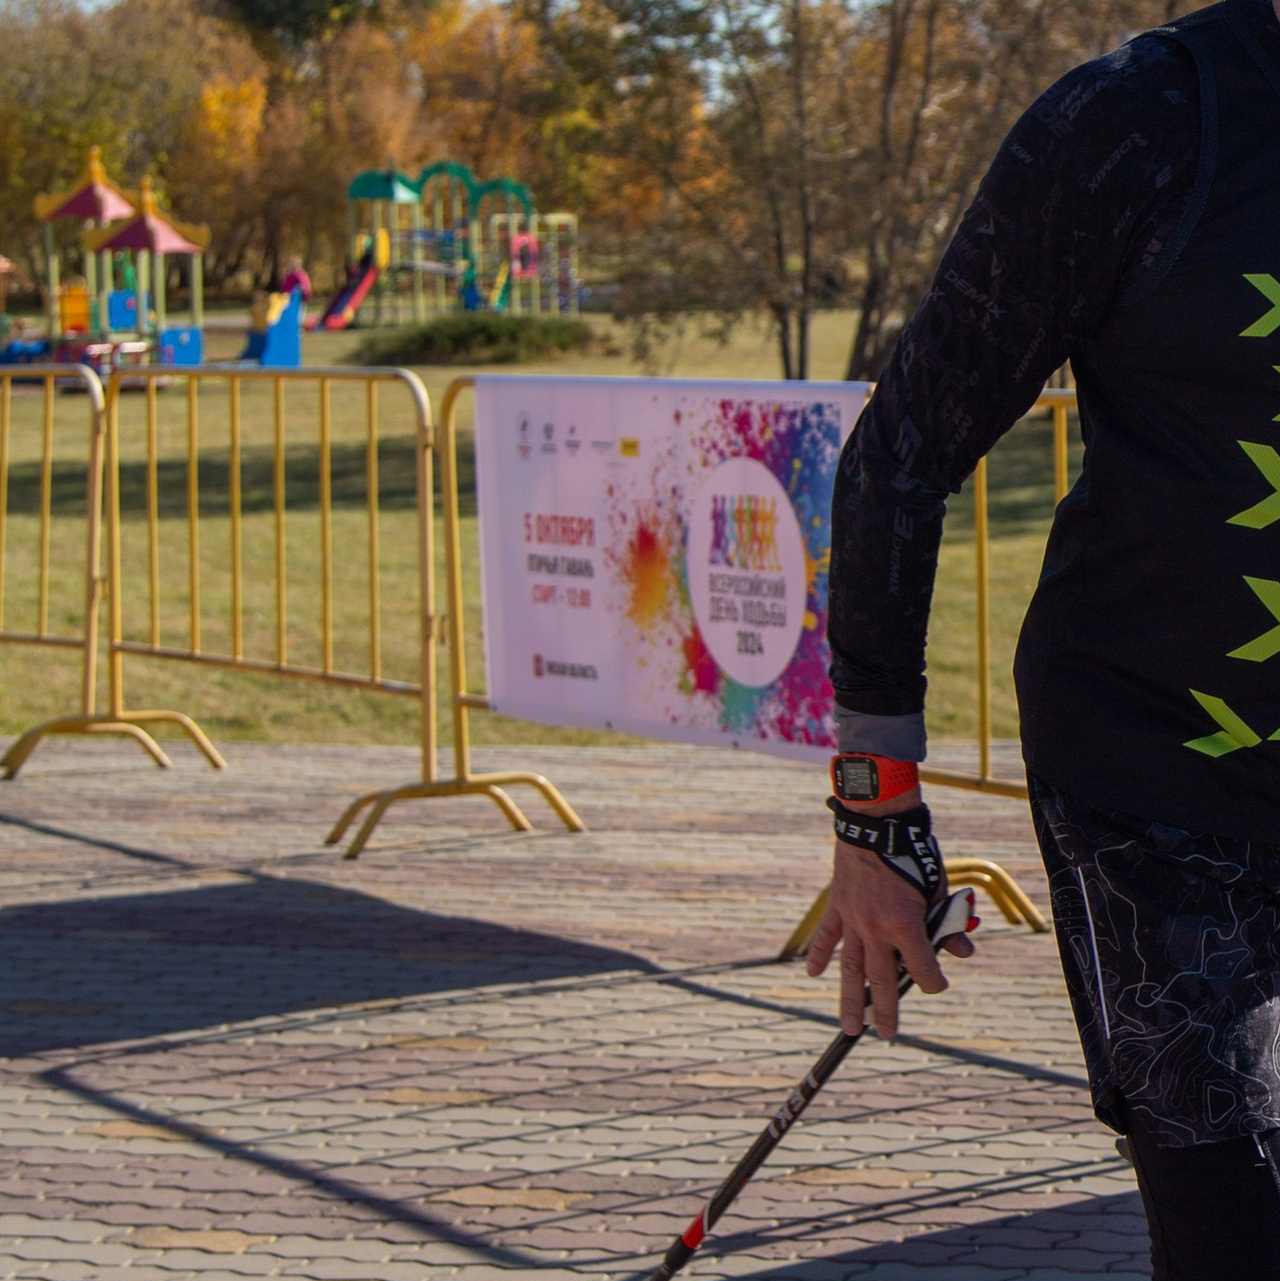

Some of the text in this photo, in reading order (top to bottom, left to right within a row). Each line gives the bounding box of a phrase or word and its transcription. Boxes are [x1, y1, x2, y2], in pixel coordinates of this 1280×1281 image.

[1066, 63, 1138, 121] DEMX
[1087, 138, 1132, 196] DEMIX
[944, 268, 1007, 320] DEMIX
[907, 826, 940, 882] LEKI
